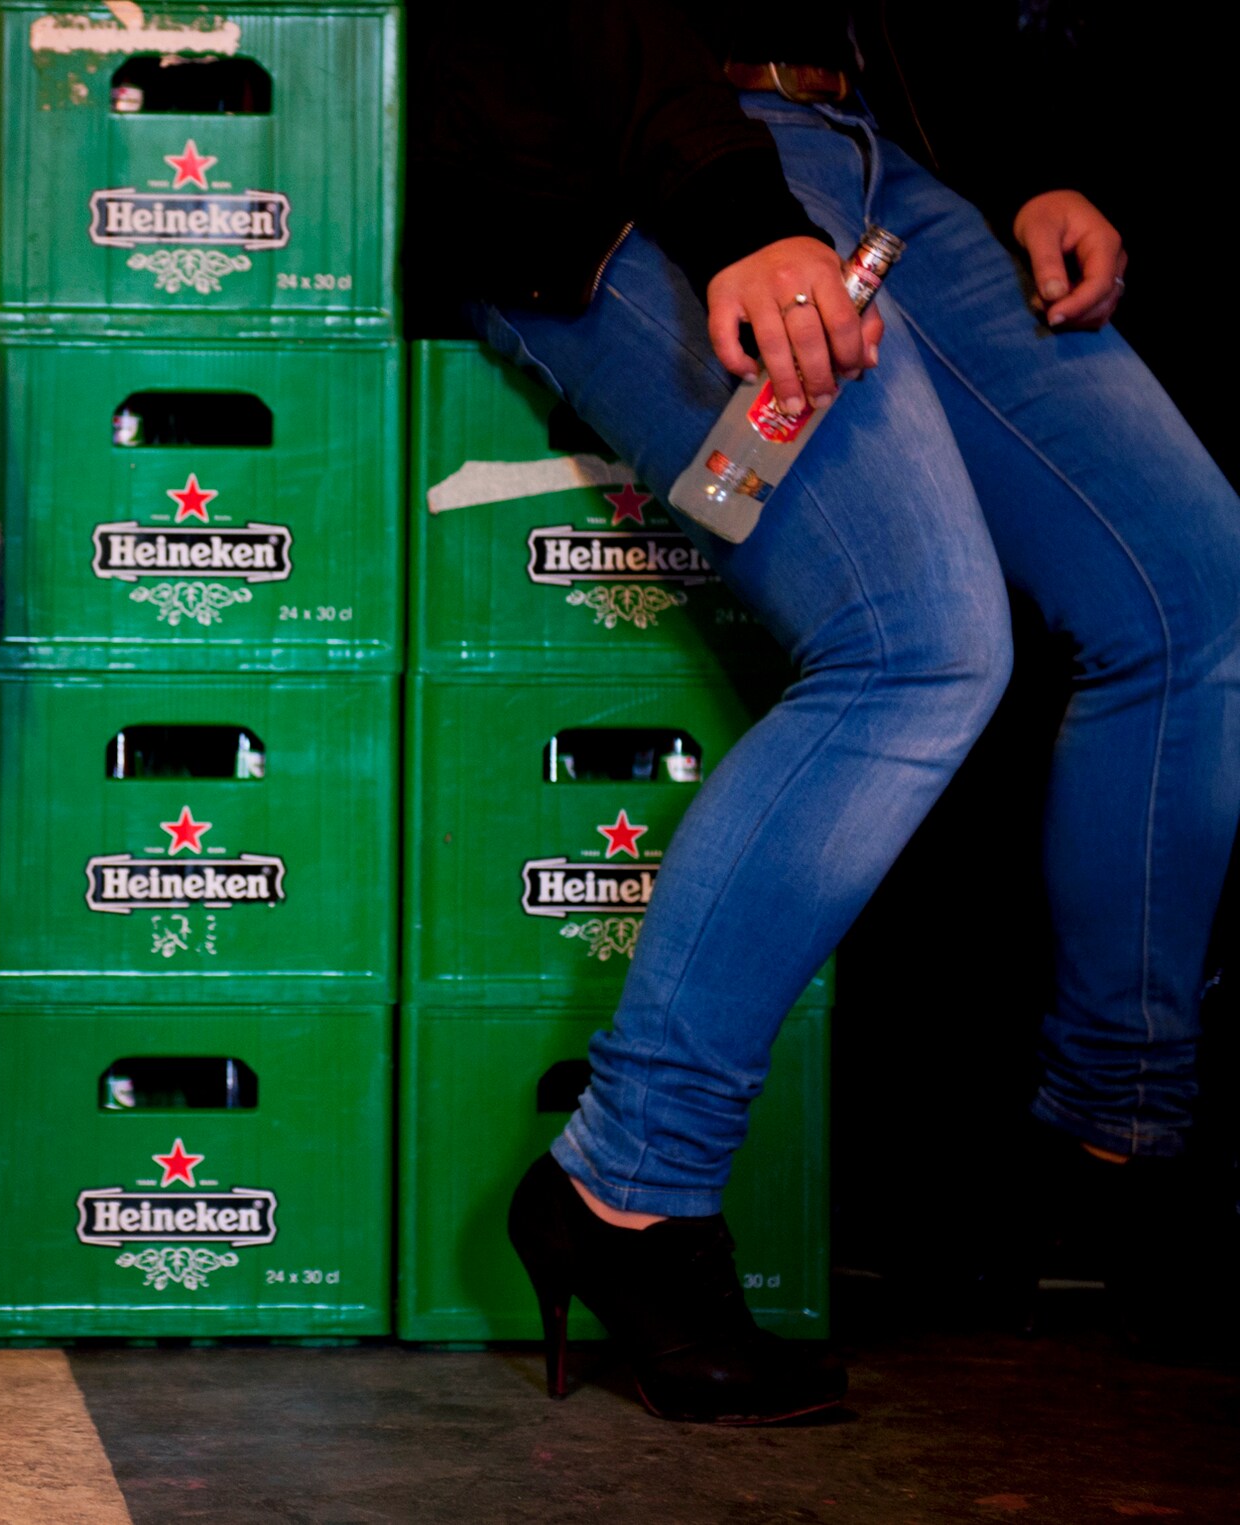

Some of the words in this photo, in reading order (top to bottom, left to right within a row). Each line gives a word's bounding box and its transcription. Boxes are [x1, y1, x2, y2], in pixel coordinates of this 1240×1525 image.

[105, 201, 276, 236] Heineken
[276, 273, 298, 290] 24
[301, 278, 311, 289] x
[314, 273, 335, 290] 30
[107, 534, 278, 569] Heineken
[278, 605, 298, 621] 24
[303, 609, 311, 620] x
[316, 606, 336, 621] 30
[101, 867, 270, 899] Heineken
[92, 1201, 263, 1233] Heineken
[265, 1269, 285, 1285] 24
[288, 1274, 298, 1284] x
[302, 1269, 322, 1285] 30
[743, 1272, 764, 1289] 30
